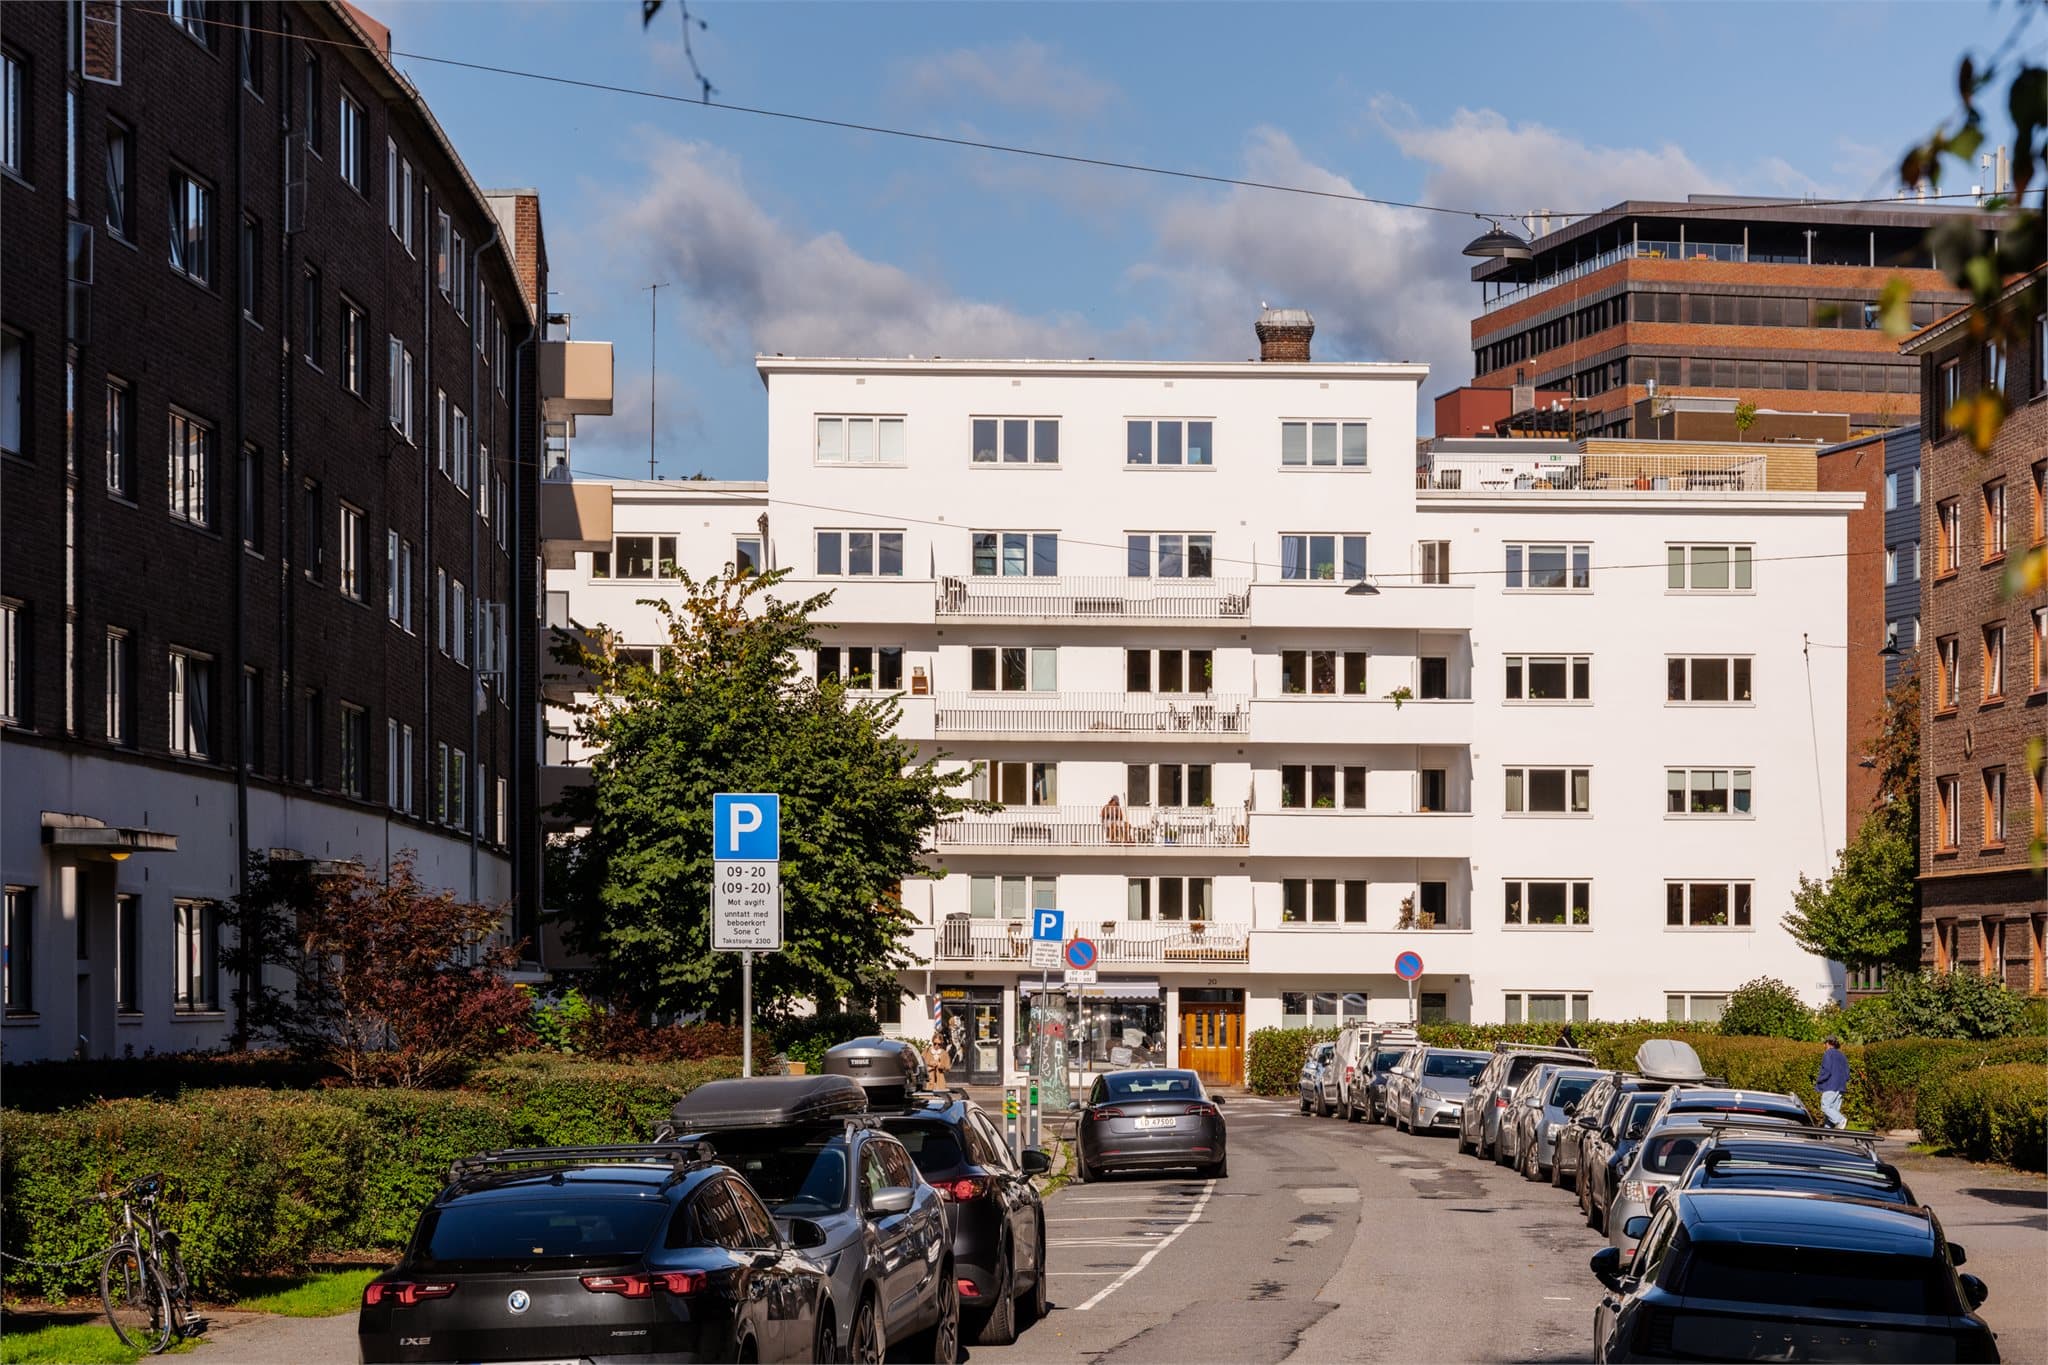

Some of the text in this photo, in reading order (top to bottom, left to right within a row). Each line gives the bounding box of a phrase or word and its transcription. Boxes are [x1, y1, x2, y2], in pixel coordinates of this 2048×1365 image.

[730, 803, 763, 852] P
[744, 899, 765, 907] avgift
[1040, 912, 1057, 937] P
